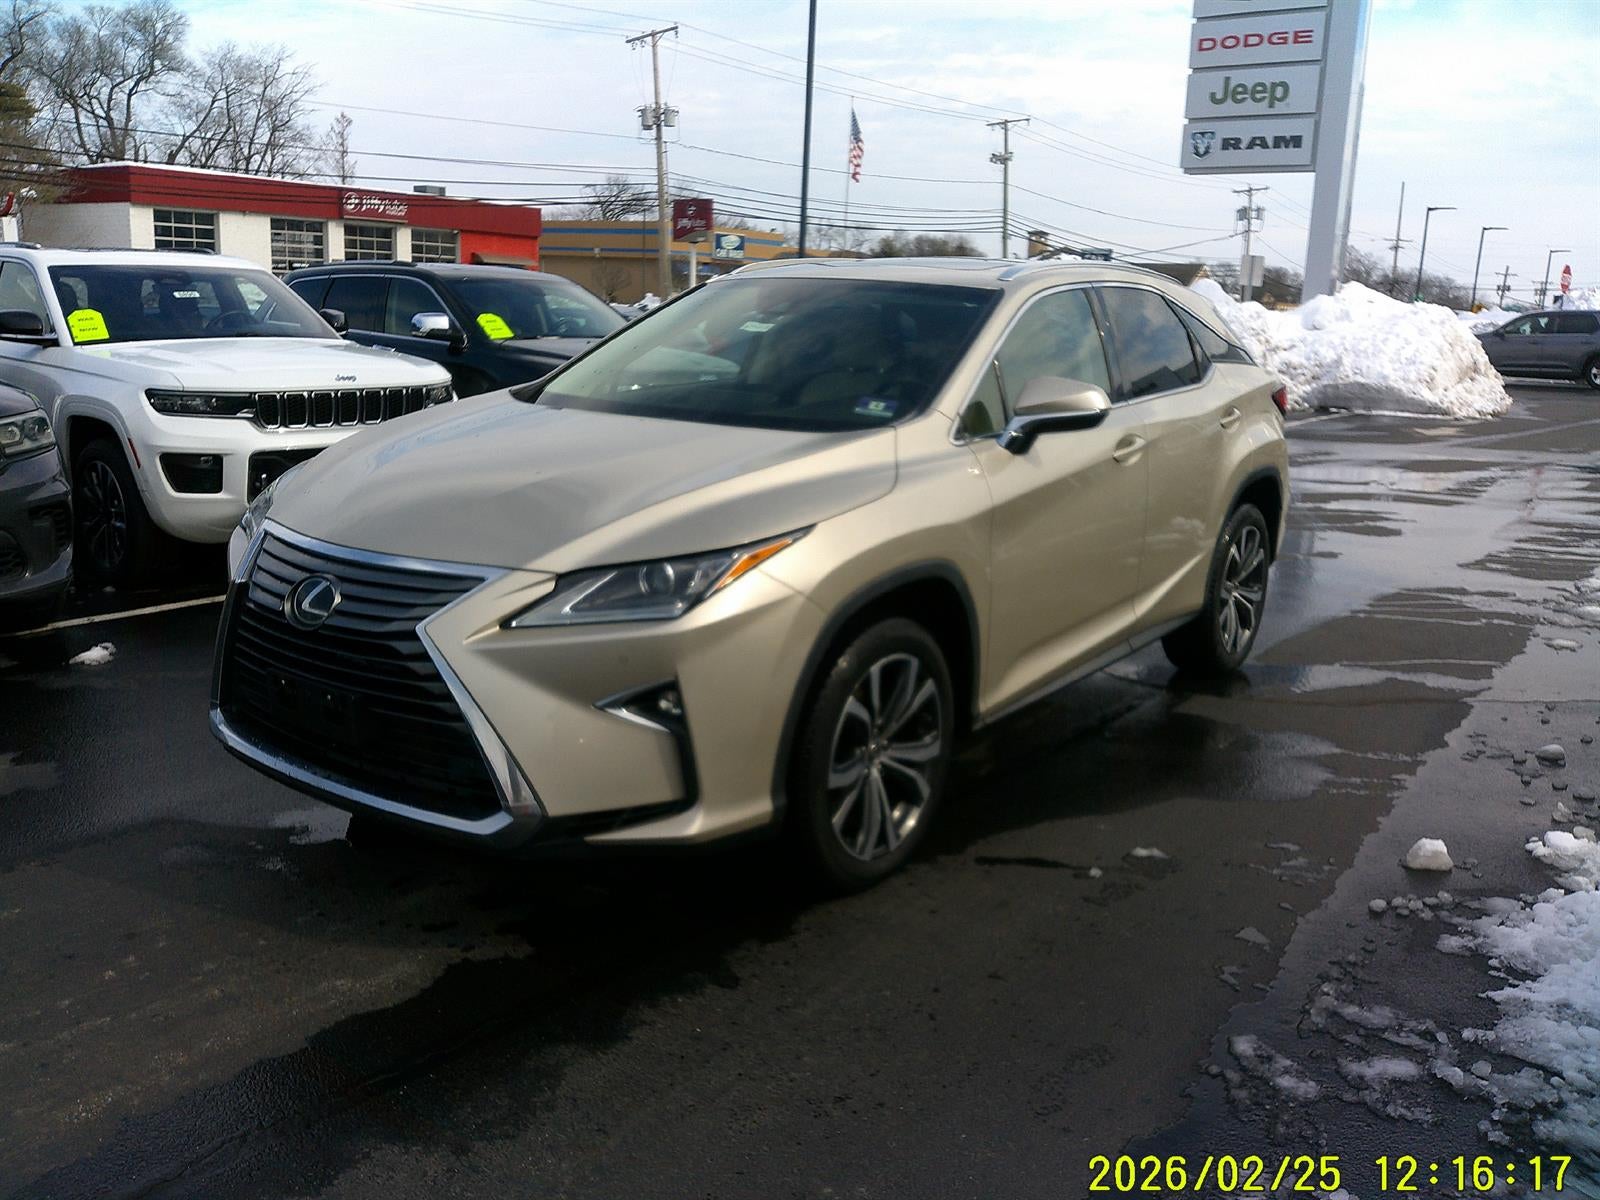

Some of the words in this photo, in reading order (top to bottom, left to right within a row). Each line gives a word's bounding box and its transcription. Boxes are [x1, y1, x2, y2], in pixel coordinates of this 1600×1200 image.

[1197, 29, 1314, 51] DODGE
[1209, 76, 1290, 108] Jeep
[1221, 135, 1303, 151] RAM
